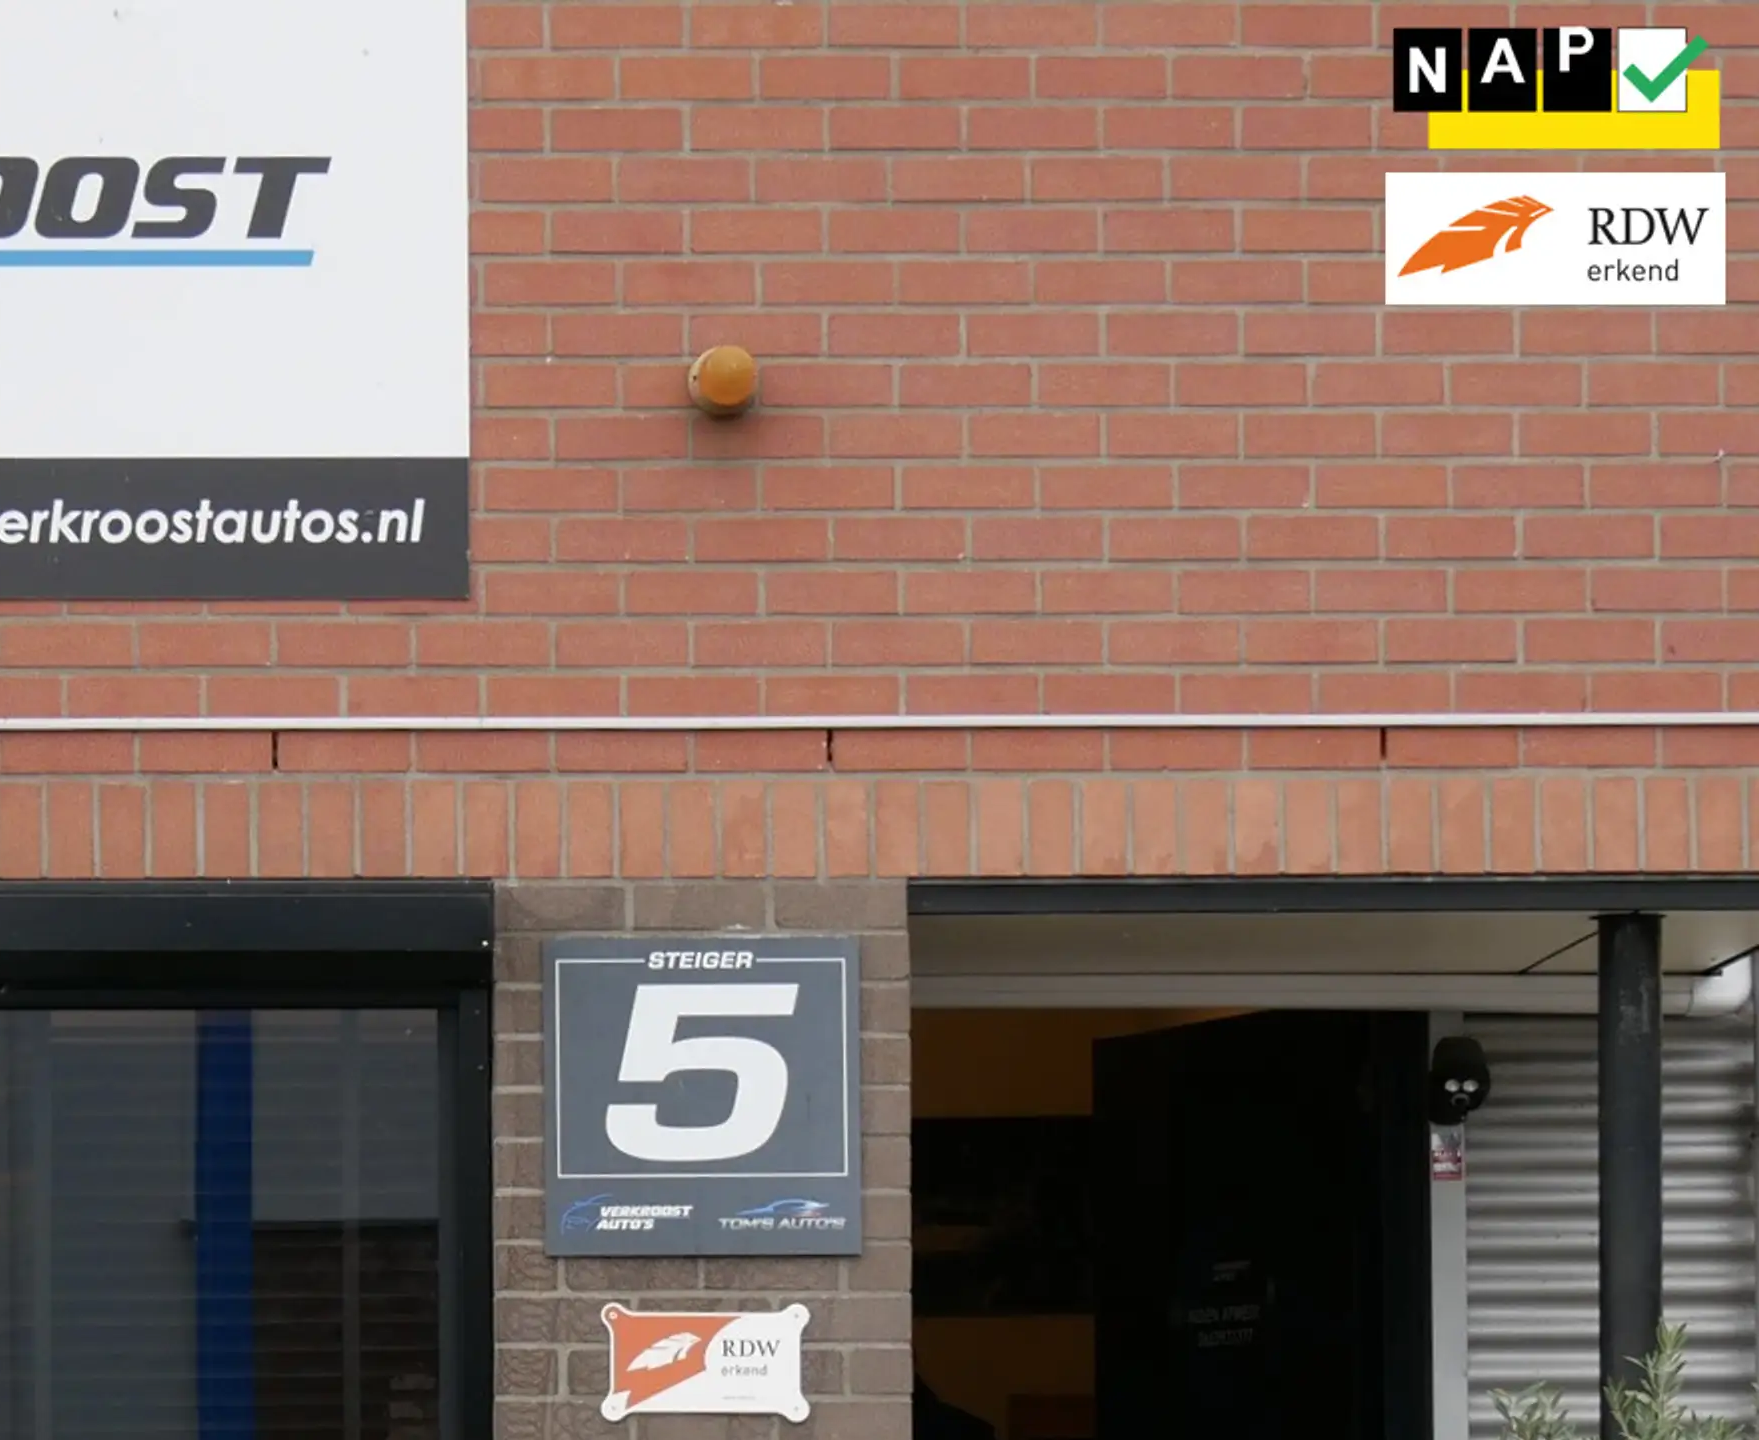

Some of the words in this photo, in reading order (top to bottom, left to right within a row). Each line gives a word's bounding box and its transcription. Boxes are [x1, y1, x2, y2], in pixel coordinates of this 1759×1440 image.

[648, 951, 754, 970] STEIGER
[605, 983, 800, 1162] 5
[599, 1205, 694, 1218] VERKROOST
[722, 1339, 781, 1357] RDW
[721, 1364, 768, 1377] erkend
